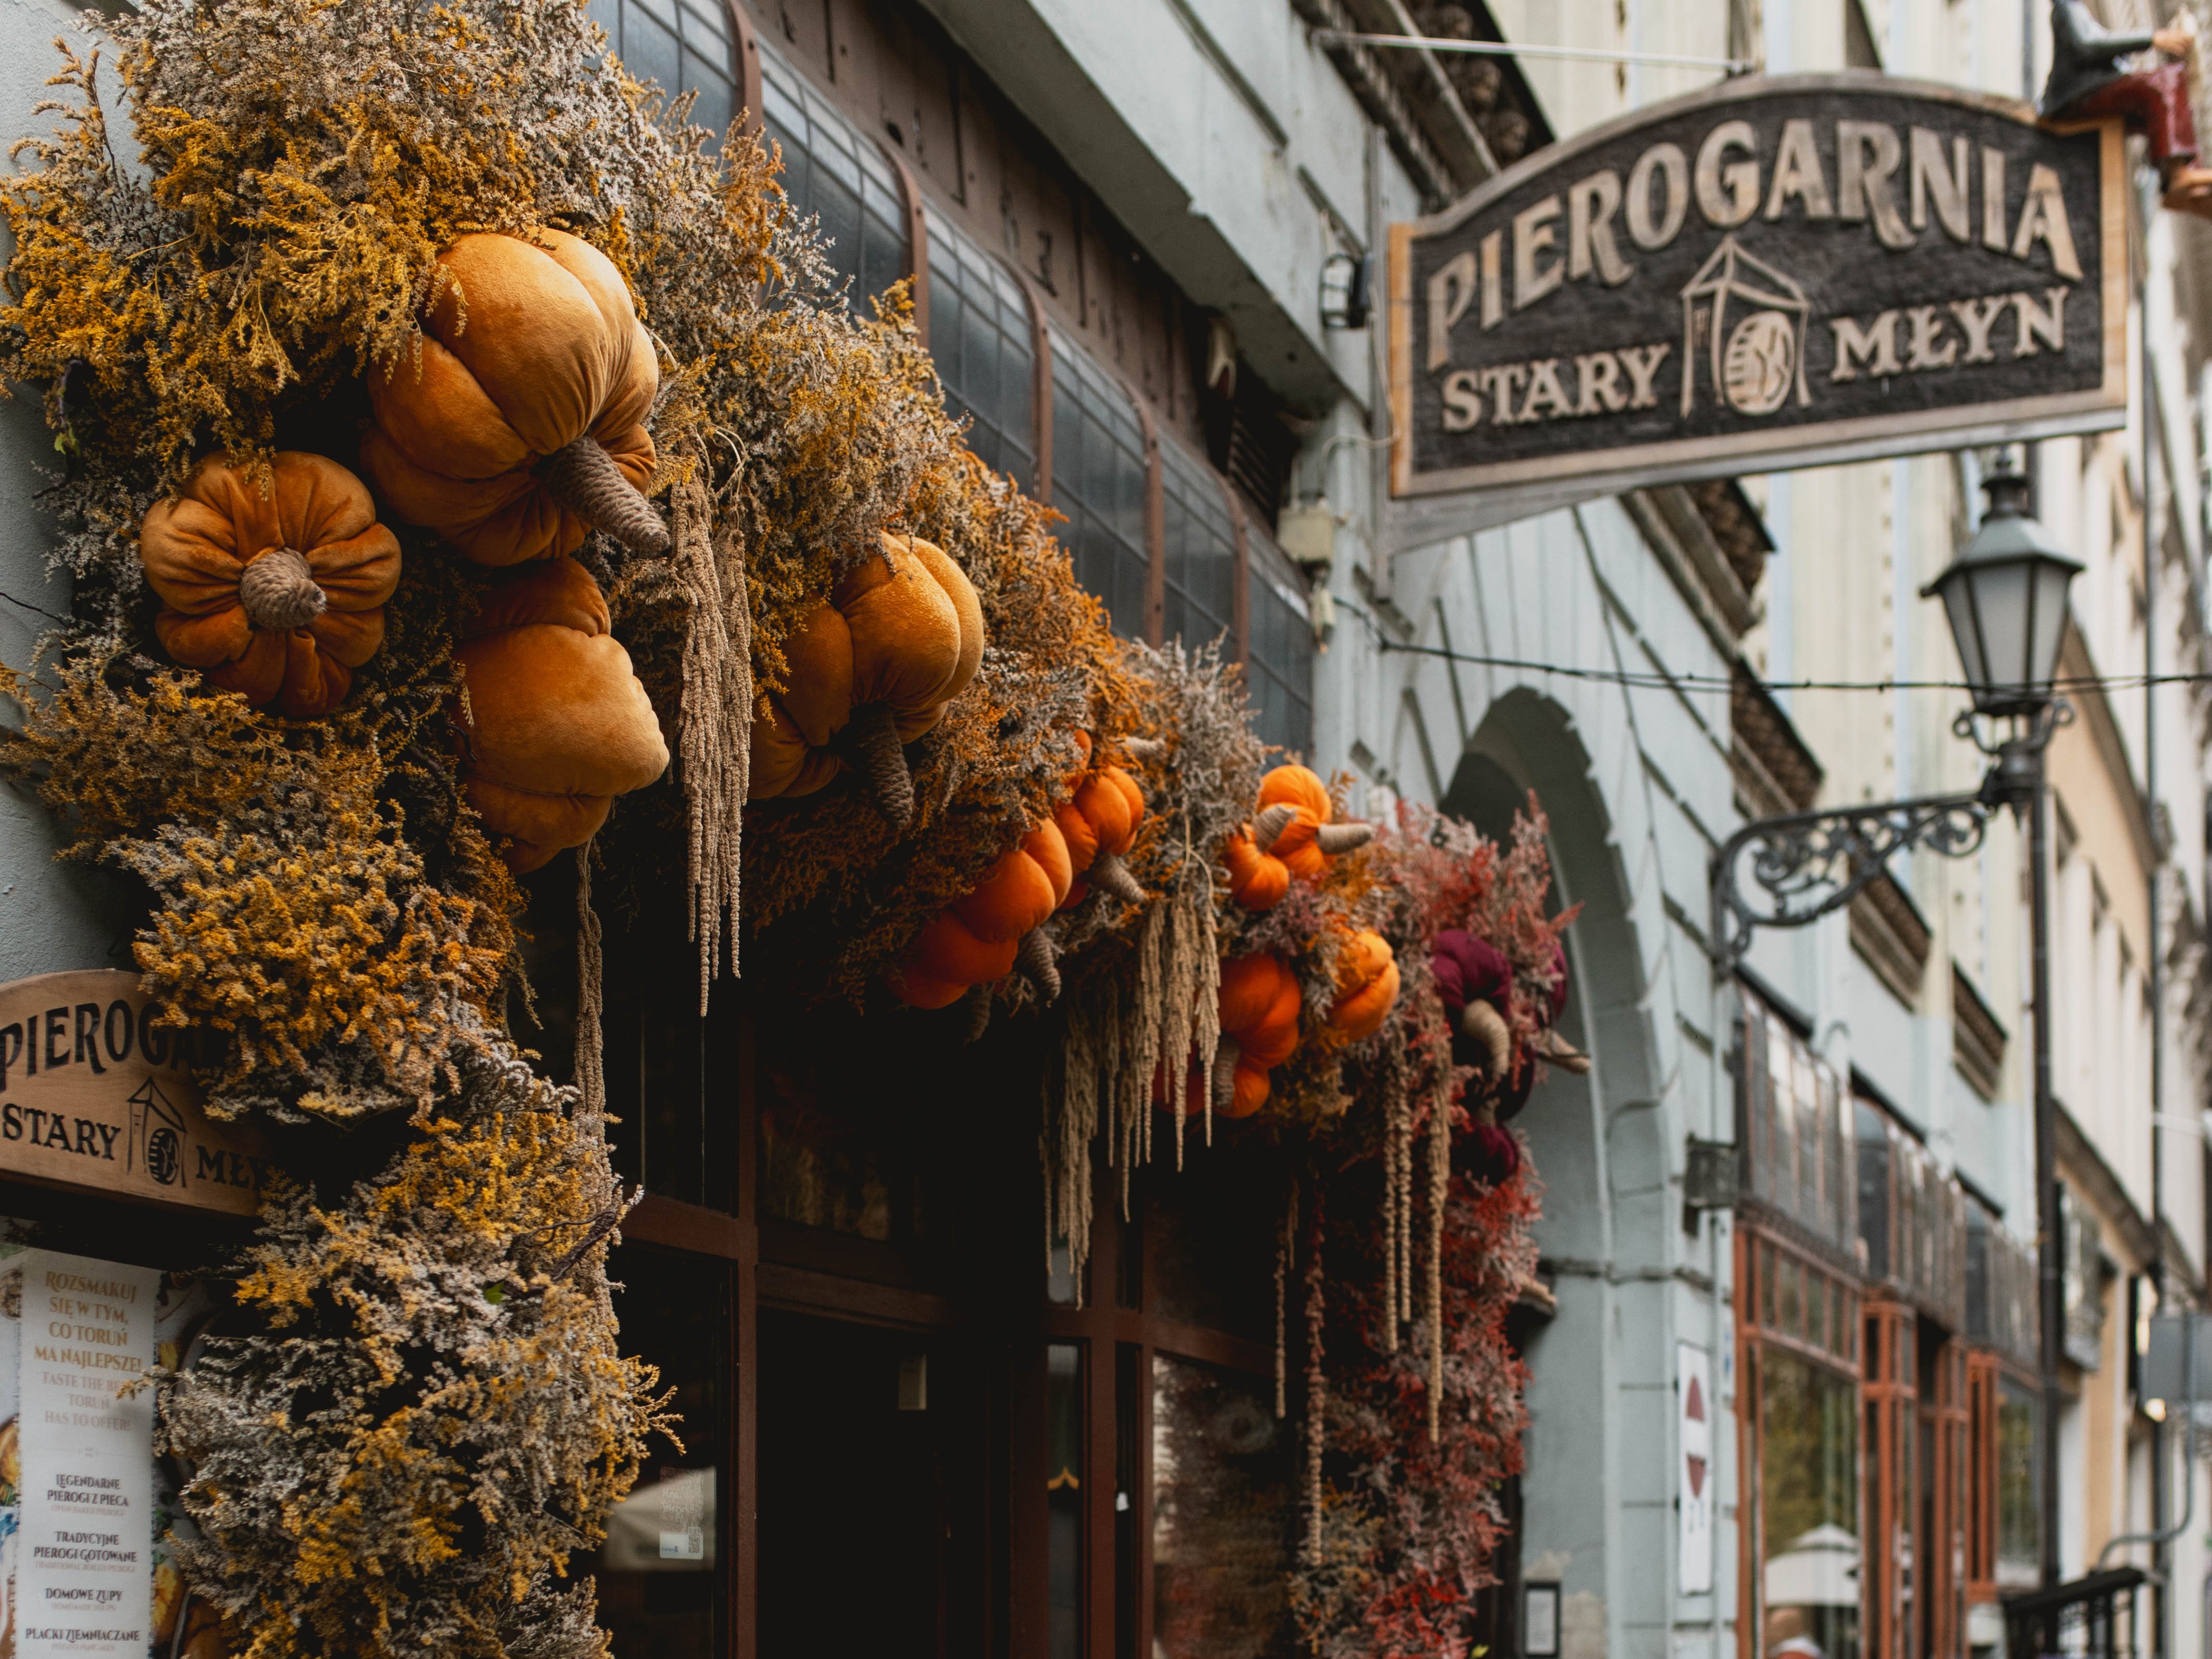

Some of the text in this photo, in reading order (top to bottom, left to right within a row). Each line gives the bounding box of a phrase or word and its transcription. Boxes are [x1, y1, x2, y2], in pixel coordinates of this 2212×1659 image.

[1427, 119, 2083, 371] PIEROGARNIA
[1442, 286, 2069, 431] STARY MŁYN
[3, 1103, 121, 1161] STARY
[45, 1271, 137, 1304] ROZSMAKUJ
[49, 1296, 128, 1326] SIĘ W TYM,
[49, 1322, 128, 1347] CO TORUŃ
[34, 1346, 142, 1373] MA NAJLEPSZE!
[40, 1371, 122, 1392] TASTE THE BE
[45, 1410, 68, 1425] HAS
[71, 1413, 88, 1427] TO
[55, 1474, 121, 1490] LEGENDARNE
[47, 1489, 129, 1507] PIEROGI Z PIECA
[54, 1531, 120, 1547] TRADYCYJNE
[34, 1546, 137, 1563] PIEROGI GOTOWANE
[45, 1588, 122, 1604] DOMOWE ZUPY
[25, 1627, 140, 1643] PLACKI ZIEMNIACZANE
